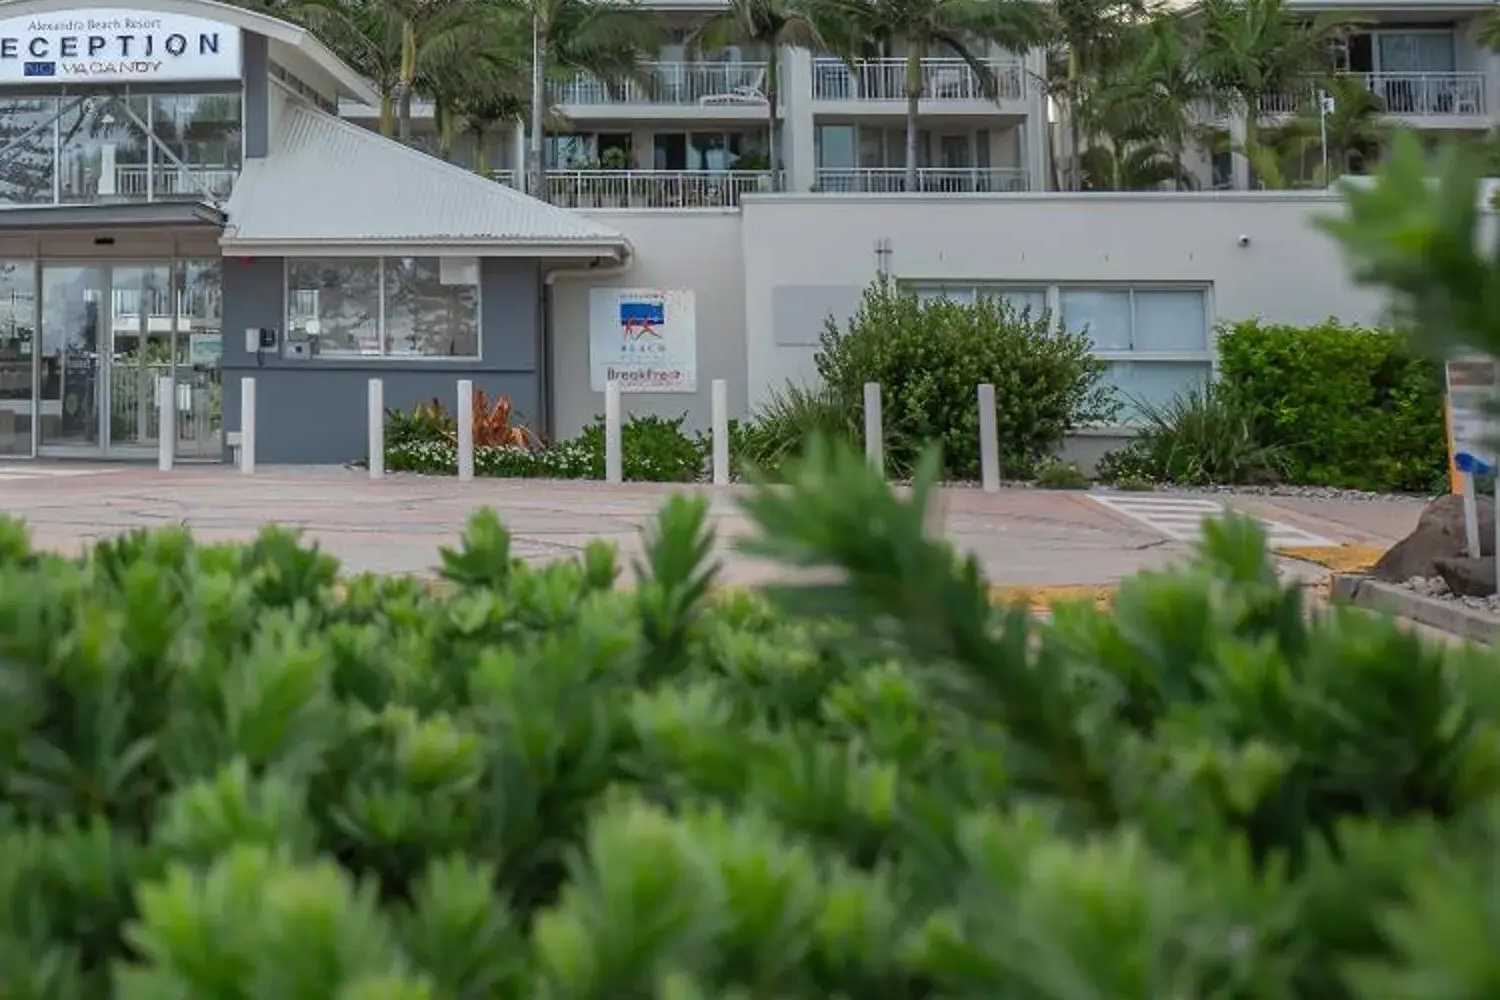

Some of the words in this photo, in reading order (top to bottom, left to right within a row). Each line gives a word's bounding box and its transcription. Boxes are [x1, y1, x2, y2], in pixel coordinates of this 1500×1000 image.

[27, 20, 84, 32] Alexandra
[86, 19, 121, 31] Beach
[124, 18, 162, 29] Resort
